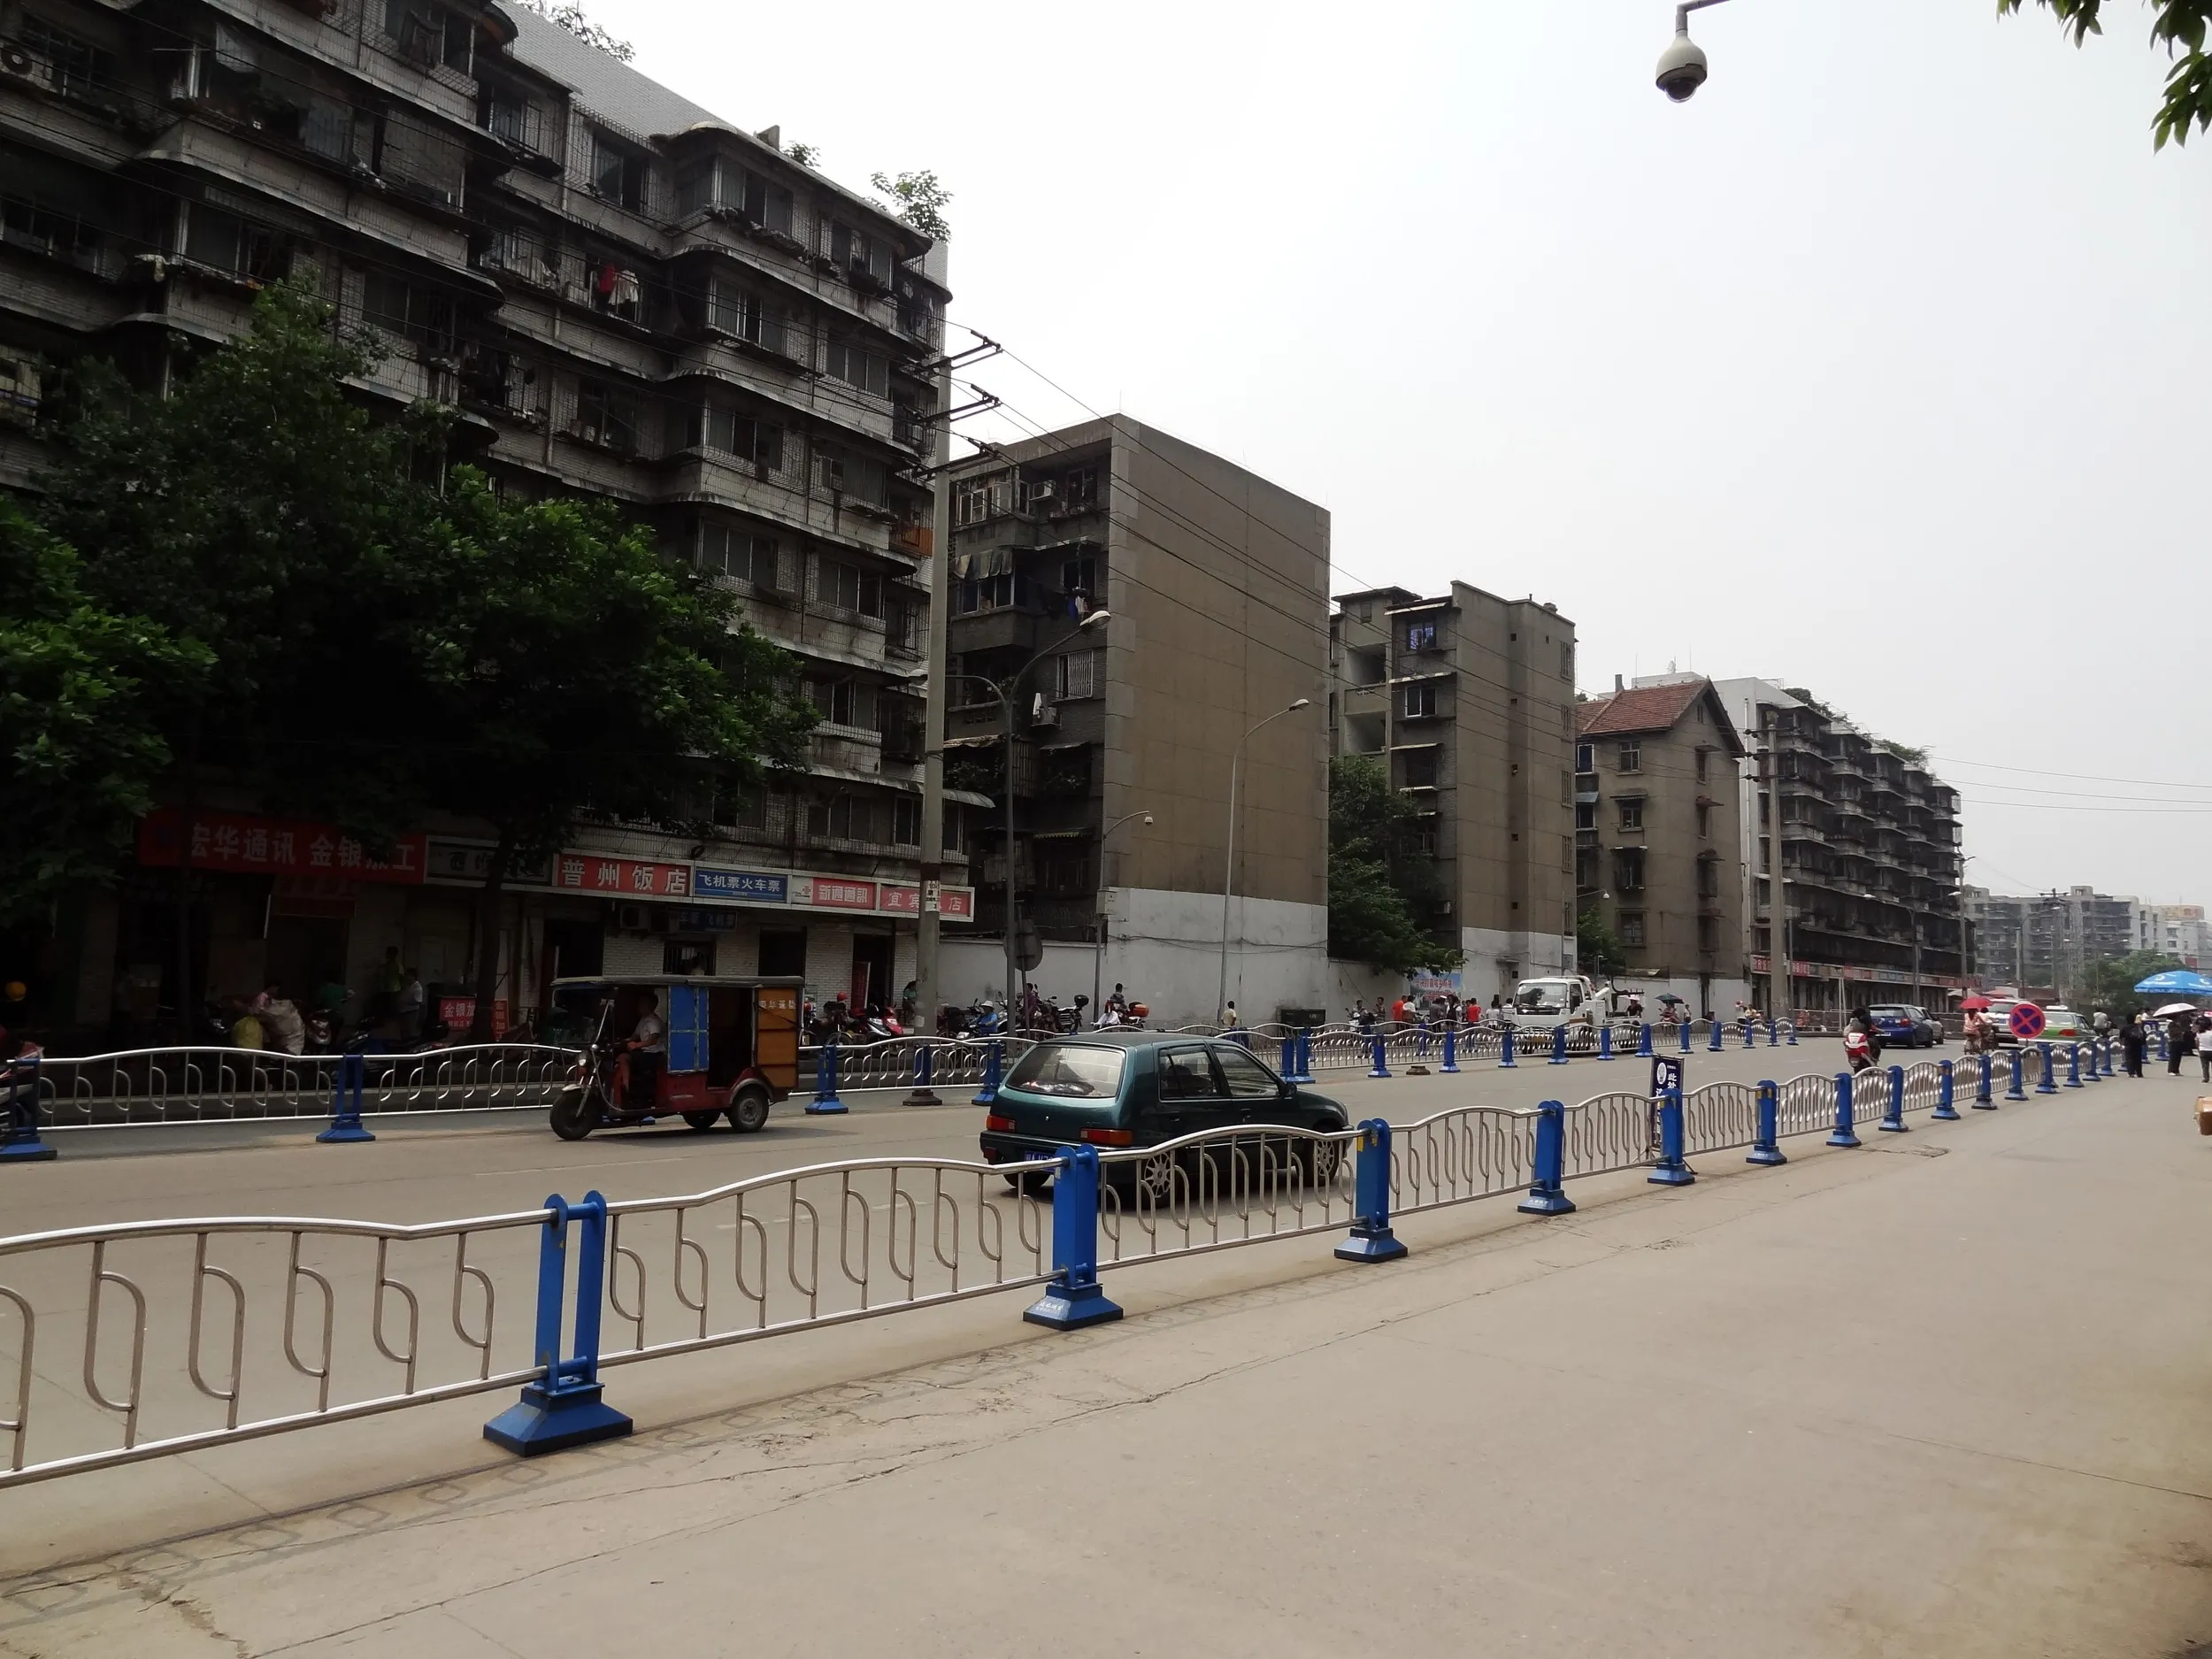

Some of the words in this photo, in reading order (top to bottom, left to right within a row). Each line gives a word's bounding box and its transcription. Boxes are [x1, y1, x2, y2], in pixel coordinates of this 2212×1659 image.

[310, 833, 416, 872] 金银工
[561, 858, 687, 895] 普州饭店
[698, 874, 780, 892] 飞机票火车票
[887, 892, 963, 911] 宜宾店
